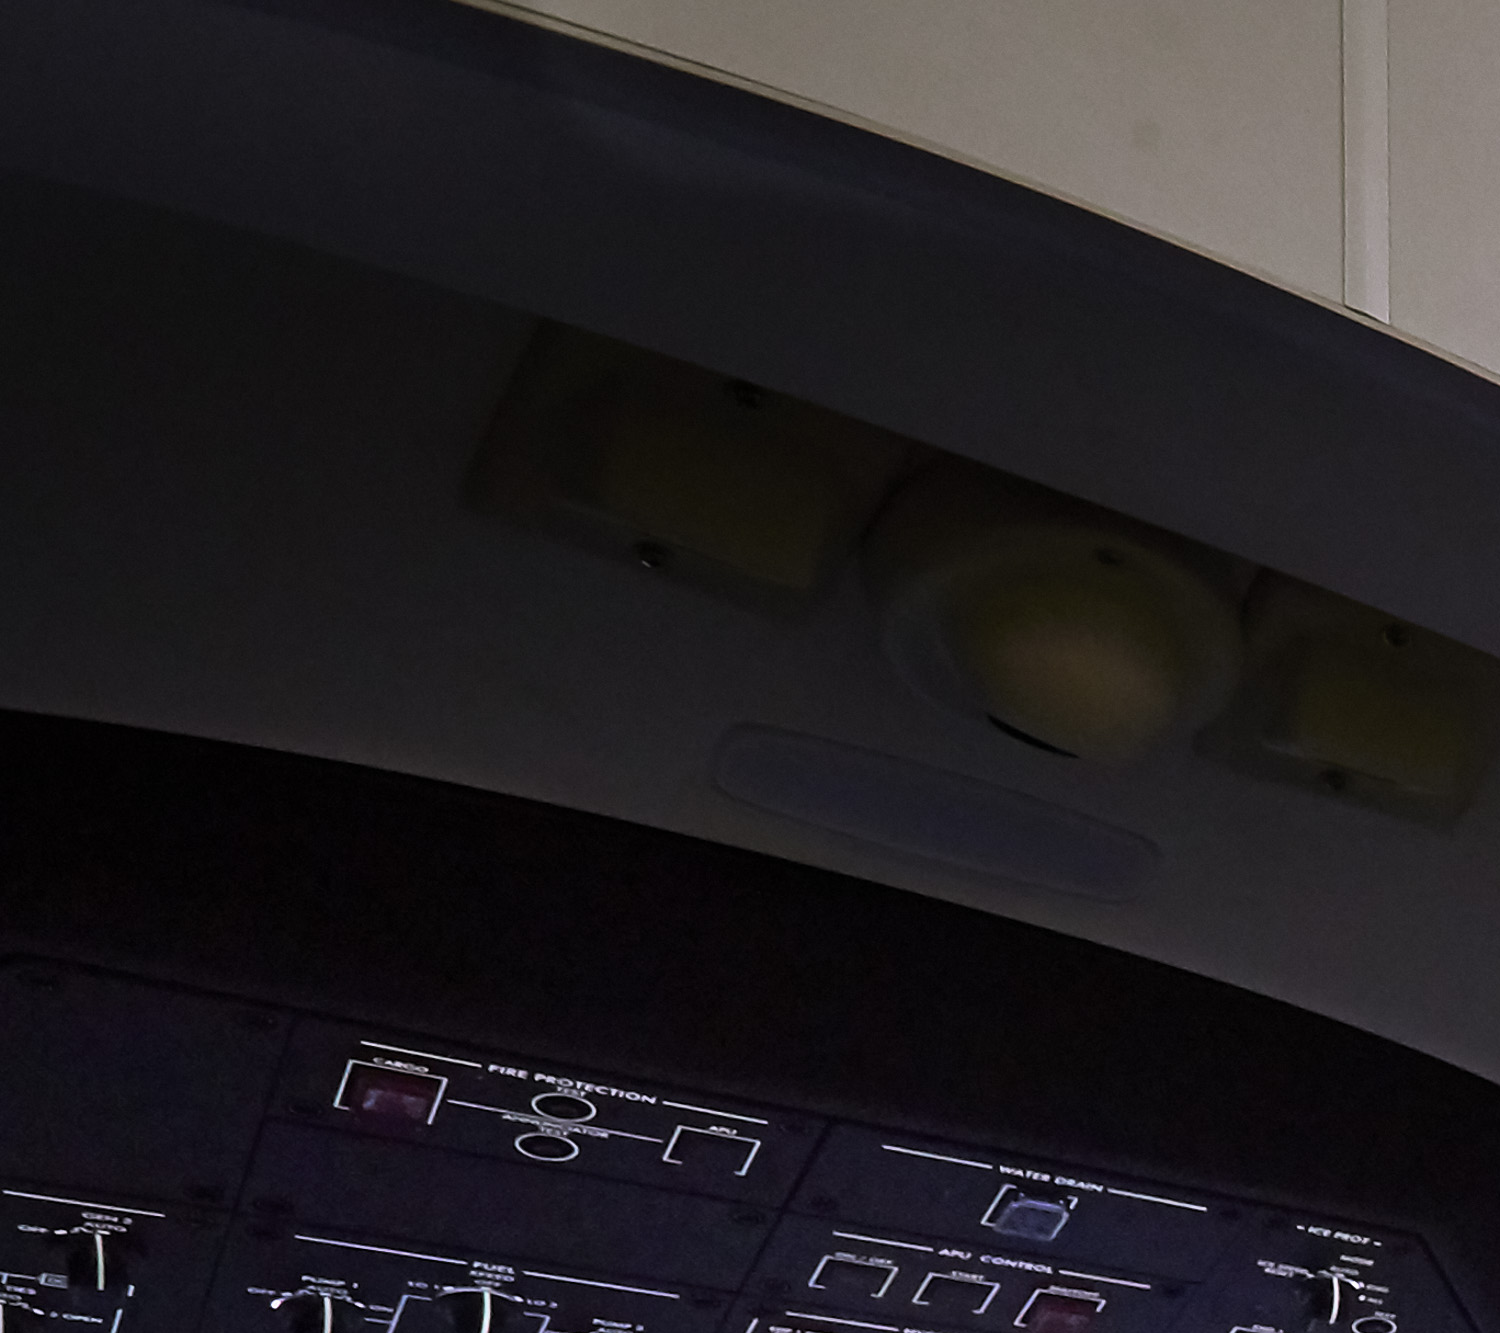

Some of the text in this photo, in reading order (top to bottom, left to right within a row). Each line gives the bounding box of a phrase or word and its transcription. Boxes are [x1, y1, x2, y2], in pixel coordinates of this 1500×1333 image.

[488, 1062, 658, 1105] FIRE PROTECTION
[998, 1165, 1104, 1193] WATER DRAIN
[939, 1247, 1052, 1275] APU CONTROL
